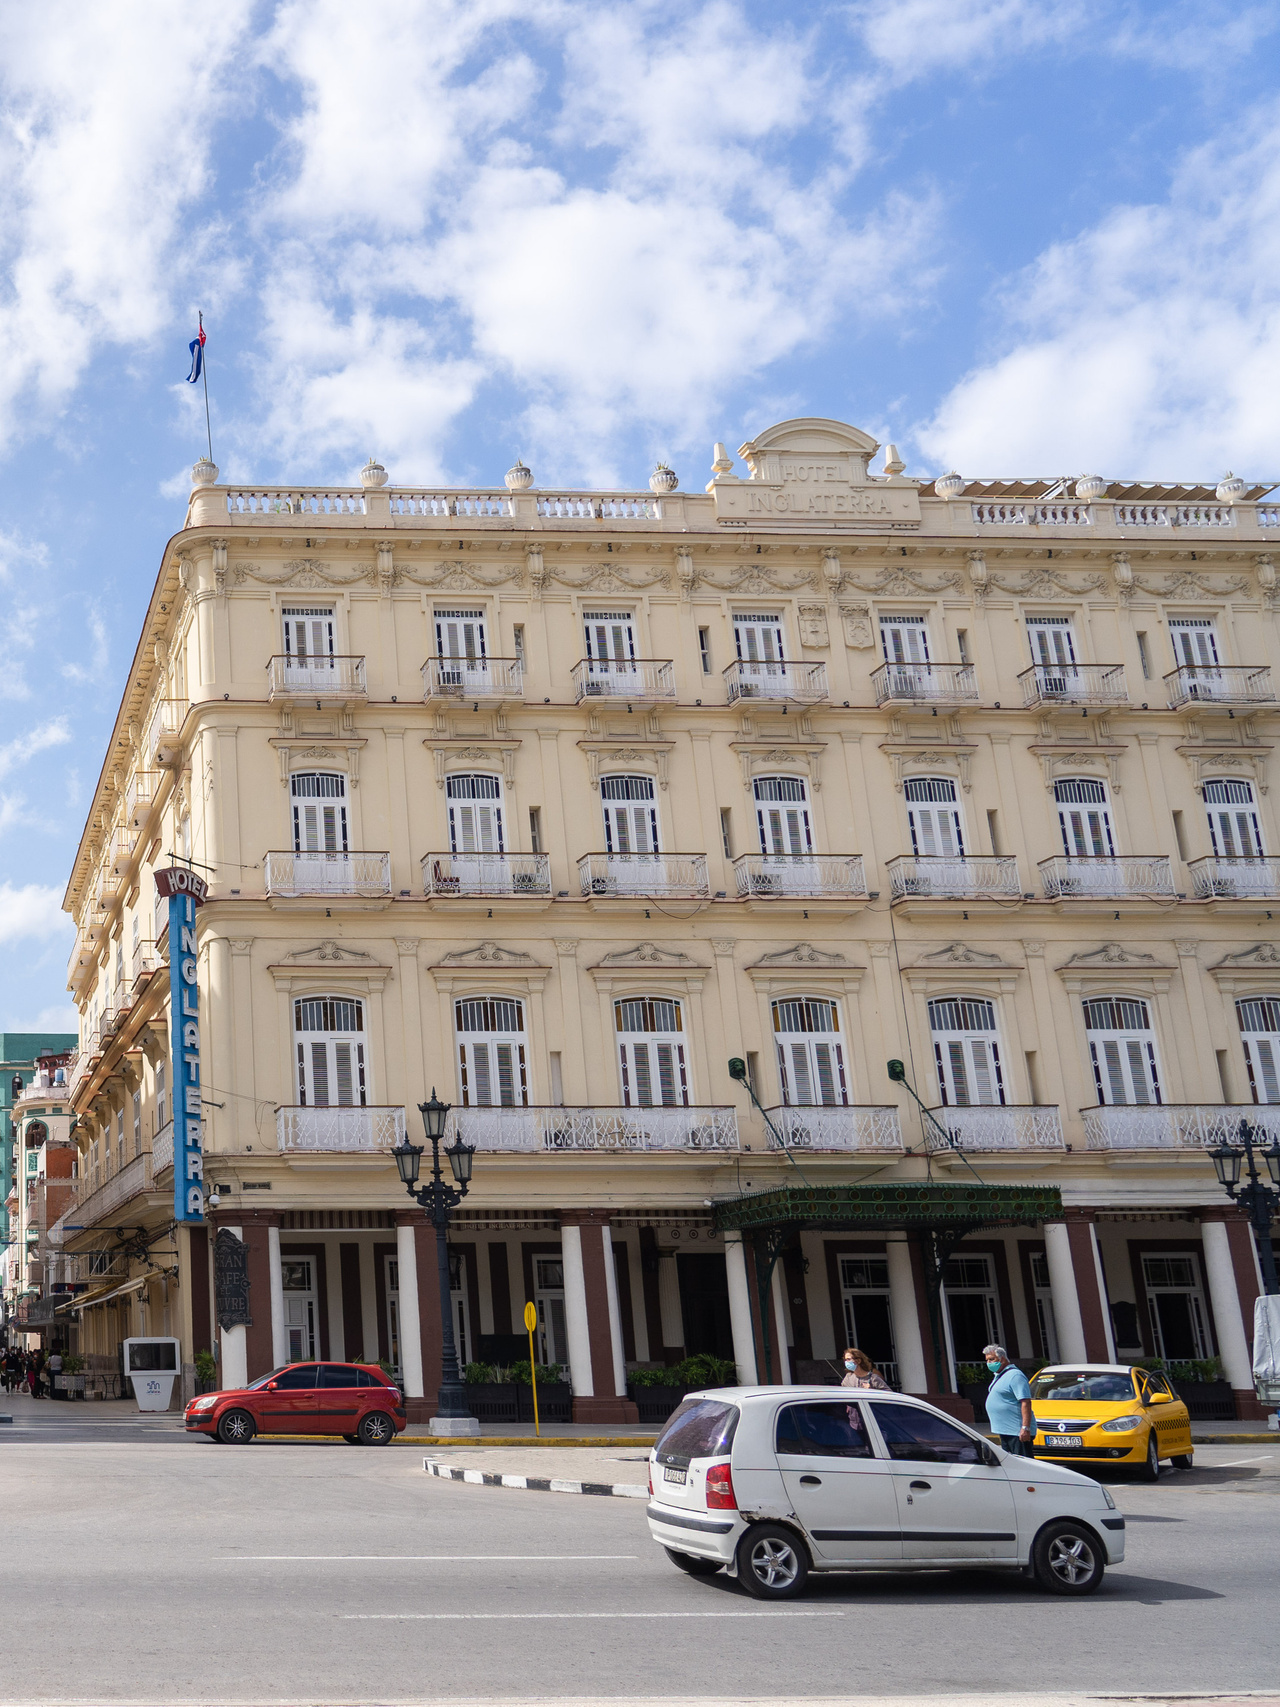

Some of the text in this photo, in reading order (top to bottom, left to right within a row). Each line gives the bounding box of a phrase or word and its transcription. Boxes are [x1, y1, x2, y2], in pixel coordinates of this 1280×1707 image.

[781, 466, 849, 482] HOTEL
[747, 493, 892, 514] INGLATERRA
[167, 870, 206, 902] HOTEL
[181, 896, 204, 1214] INGLATERRA
